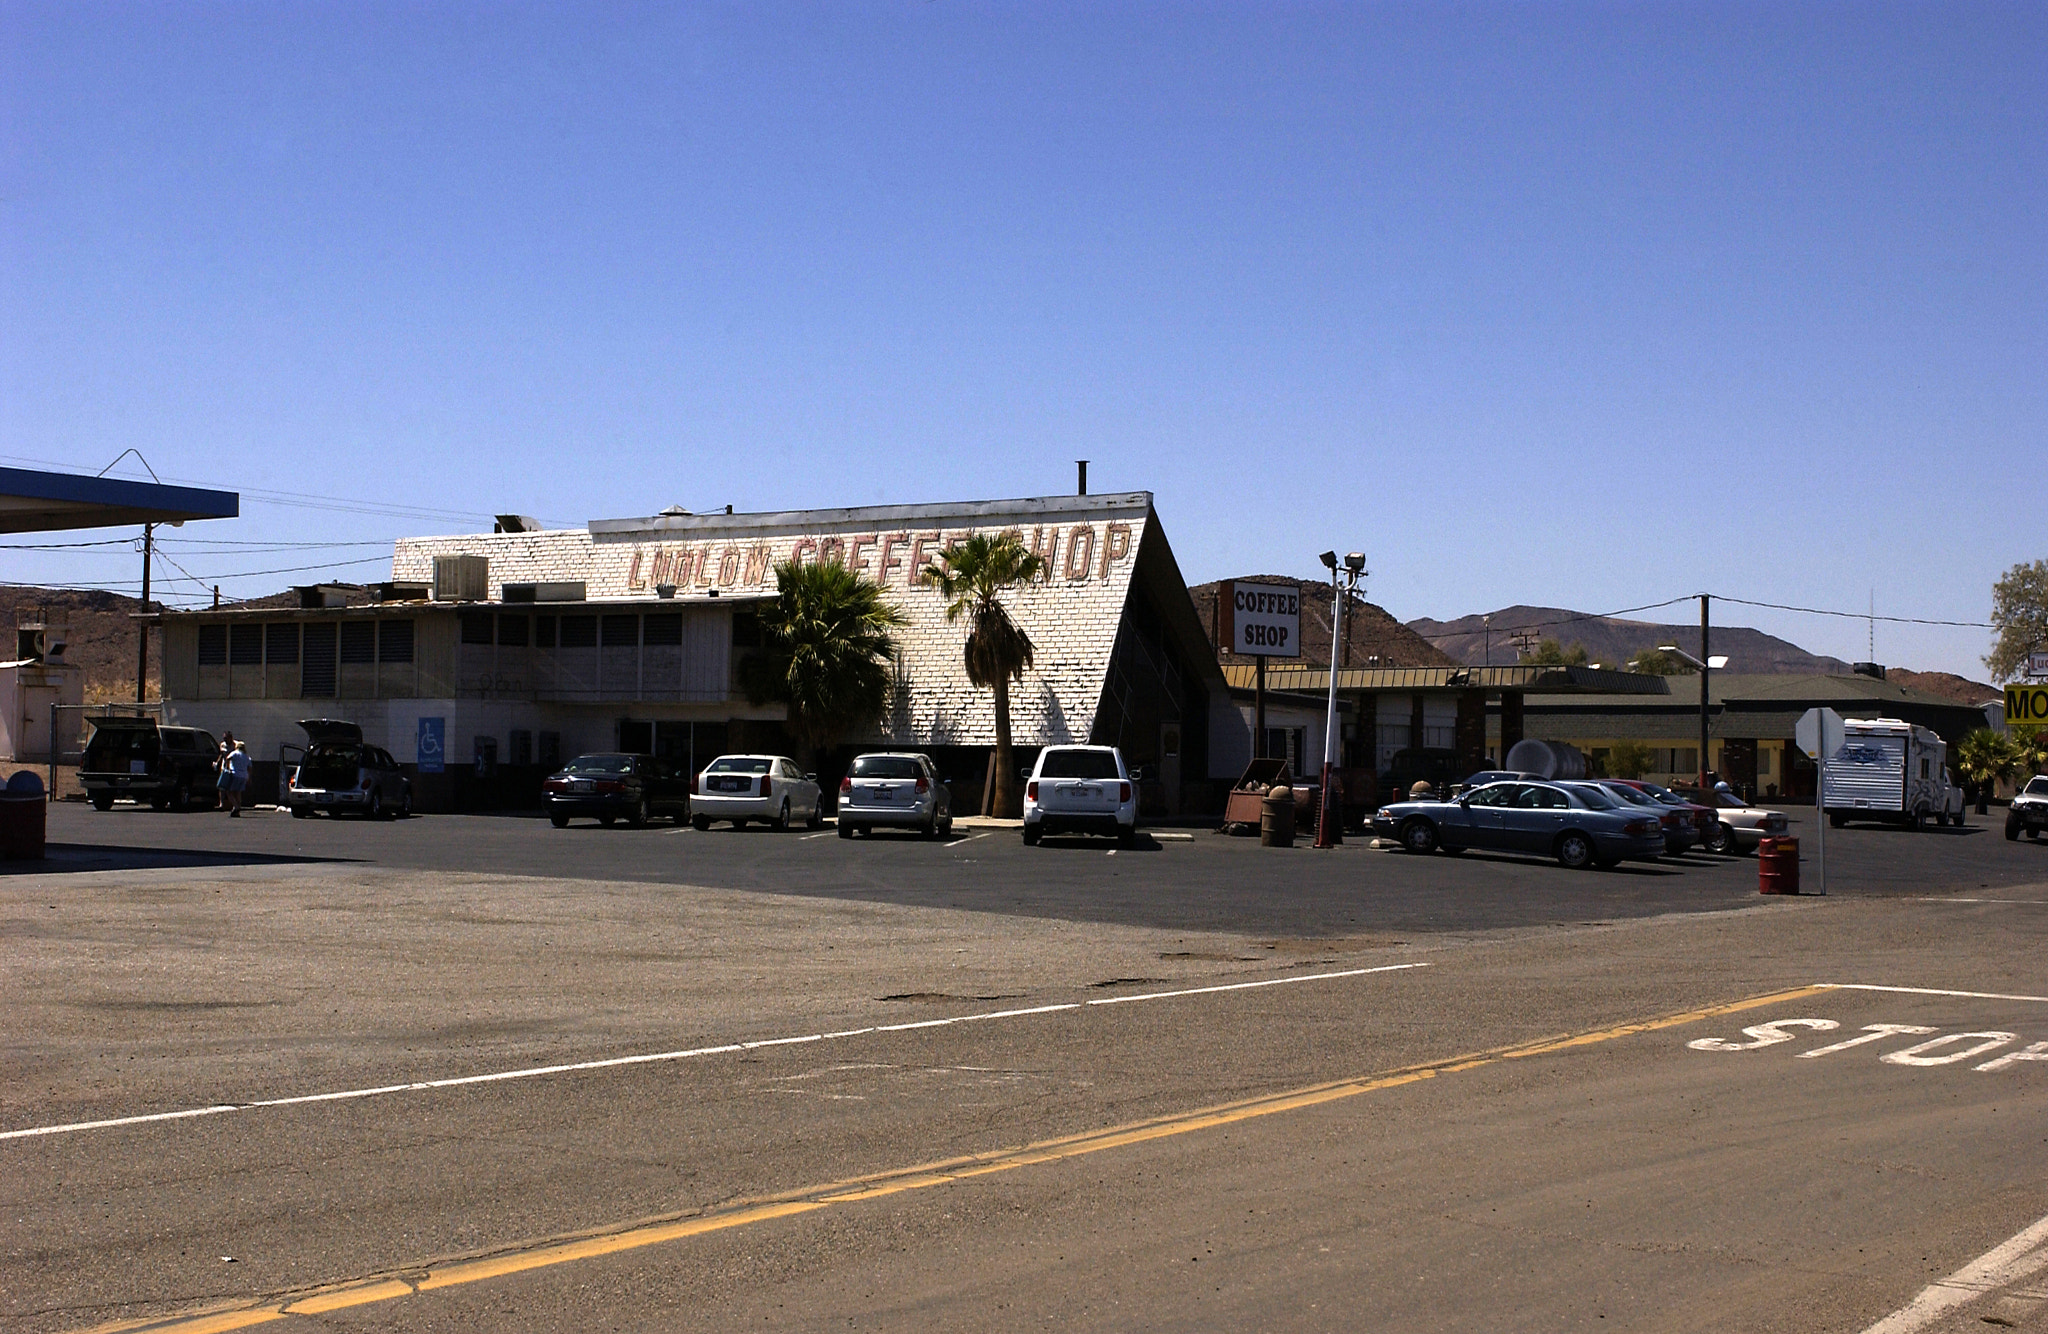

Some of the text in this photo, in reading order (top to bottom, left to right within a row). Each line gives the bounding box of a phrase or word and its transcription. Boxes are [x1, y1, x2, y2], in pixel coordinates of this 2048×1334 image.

[628, 546, 772, 590] LUDLOW
[996, 523, 1132, 583] HOP
[1234, 590, 1298, 616] COFFEE
[1244, 624, 1289, 647] SHOP
[2006, 690, 2048, 719] MO
